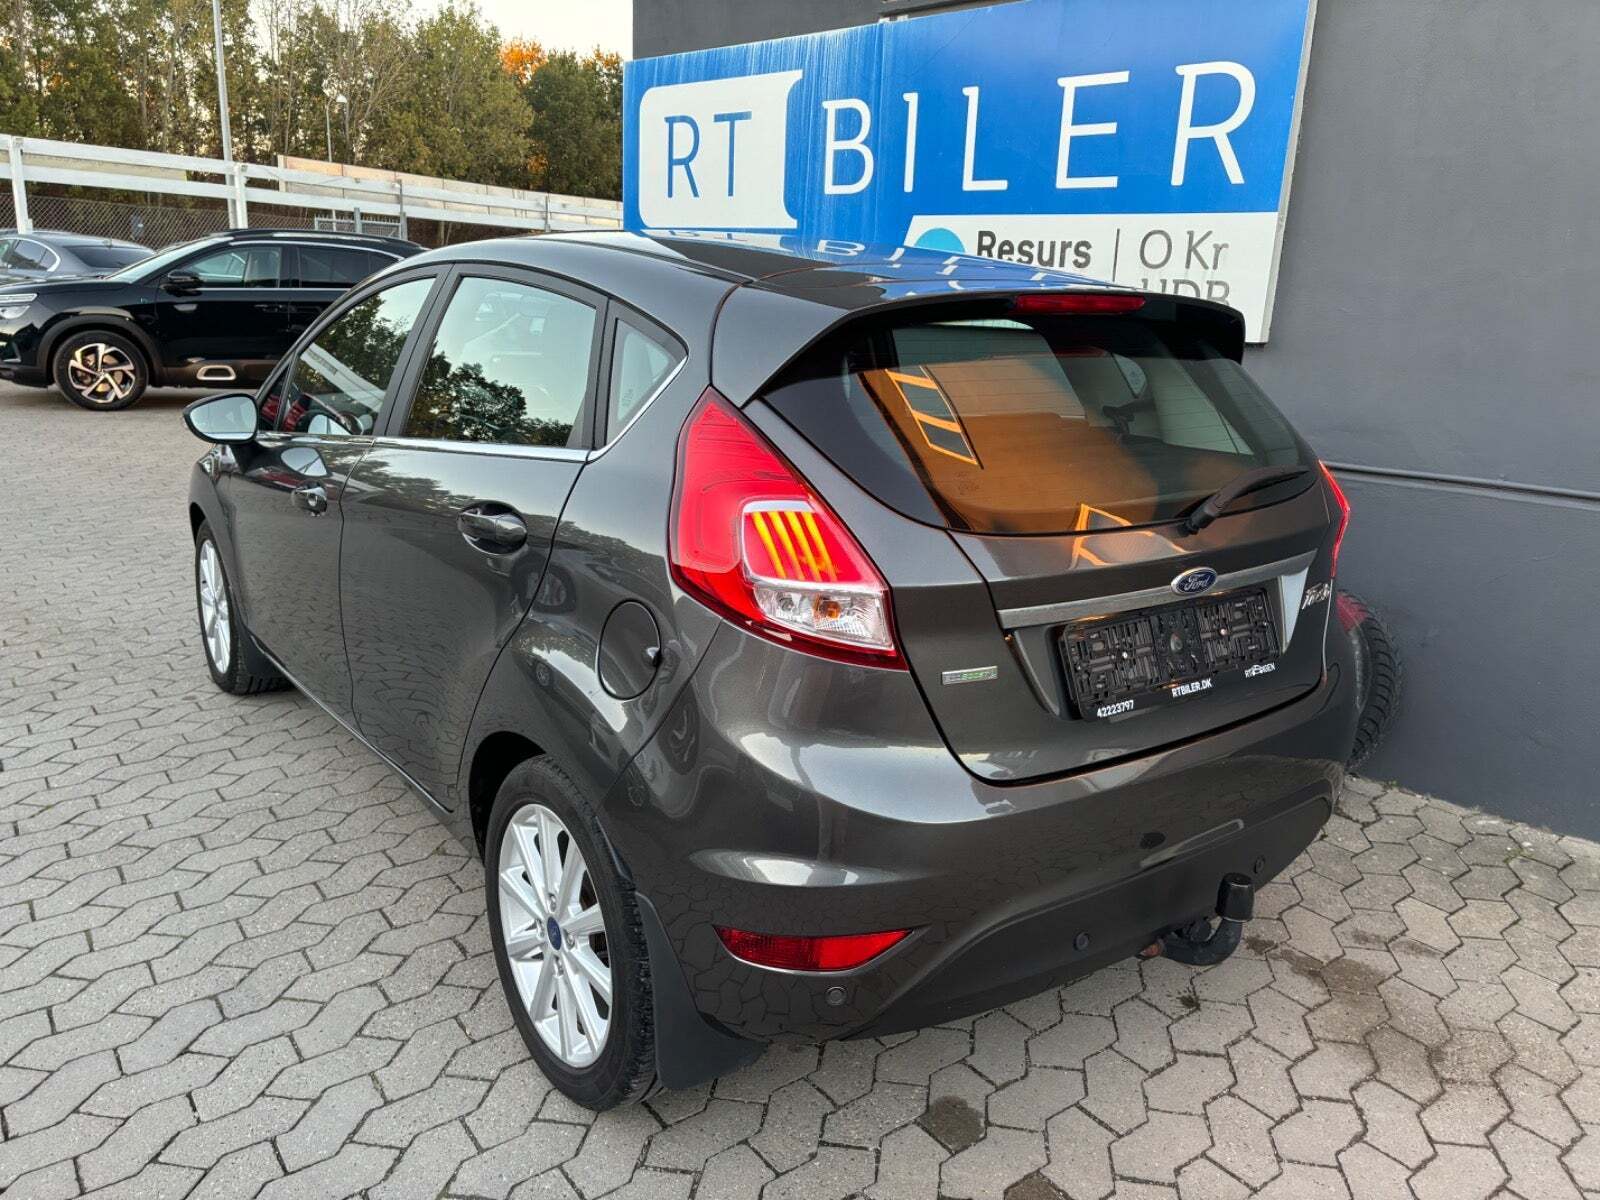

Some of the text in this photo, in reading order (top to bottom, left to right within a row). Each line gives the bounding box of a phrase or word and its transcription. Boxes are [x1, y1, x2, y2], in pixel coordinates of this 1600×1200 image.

[664, 61, 1256, 199] RT BILER
[977, 230, 1092, 268] Resurs
[1185, 230, 1229, 270] Kr
[1183, 572, 1211, 591] Ford
[1172, 678, 1212, 698] RTBILER.DK
[1097, 699, 1134, 718] 42223797
